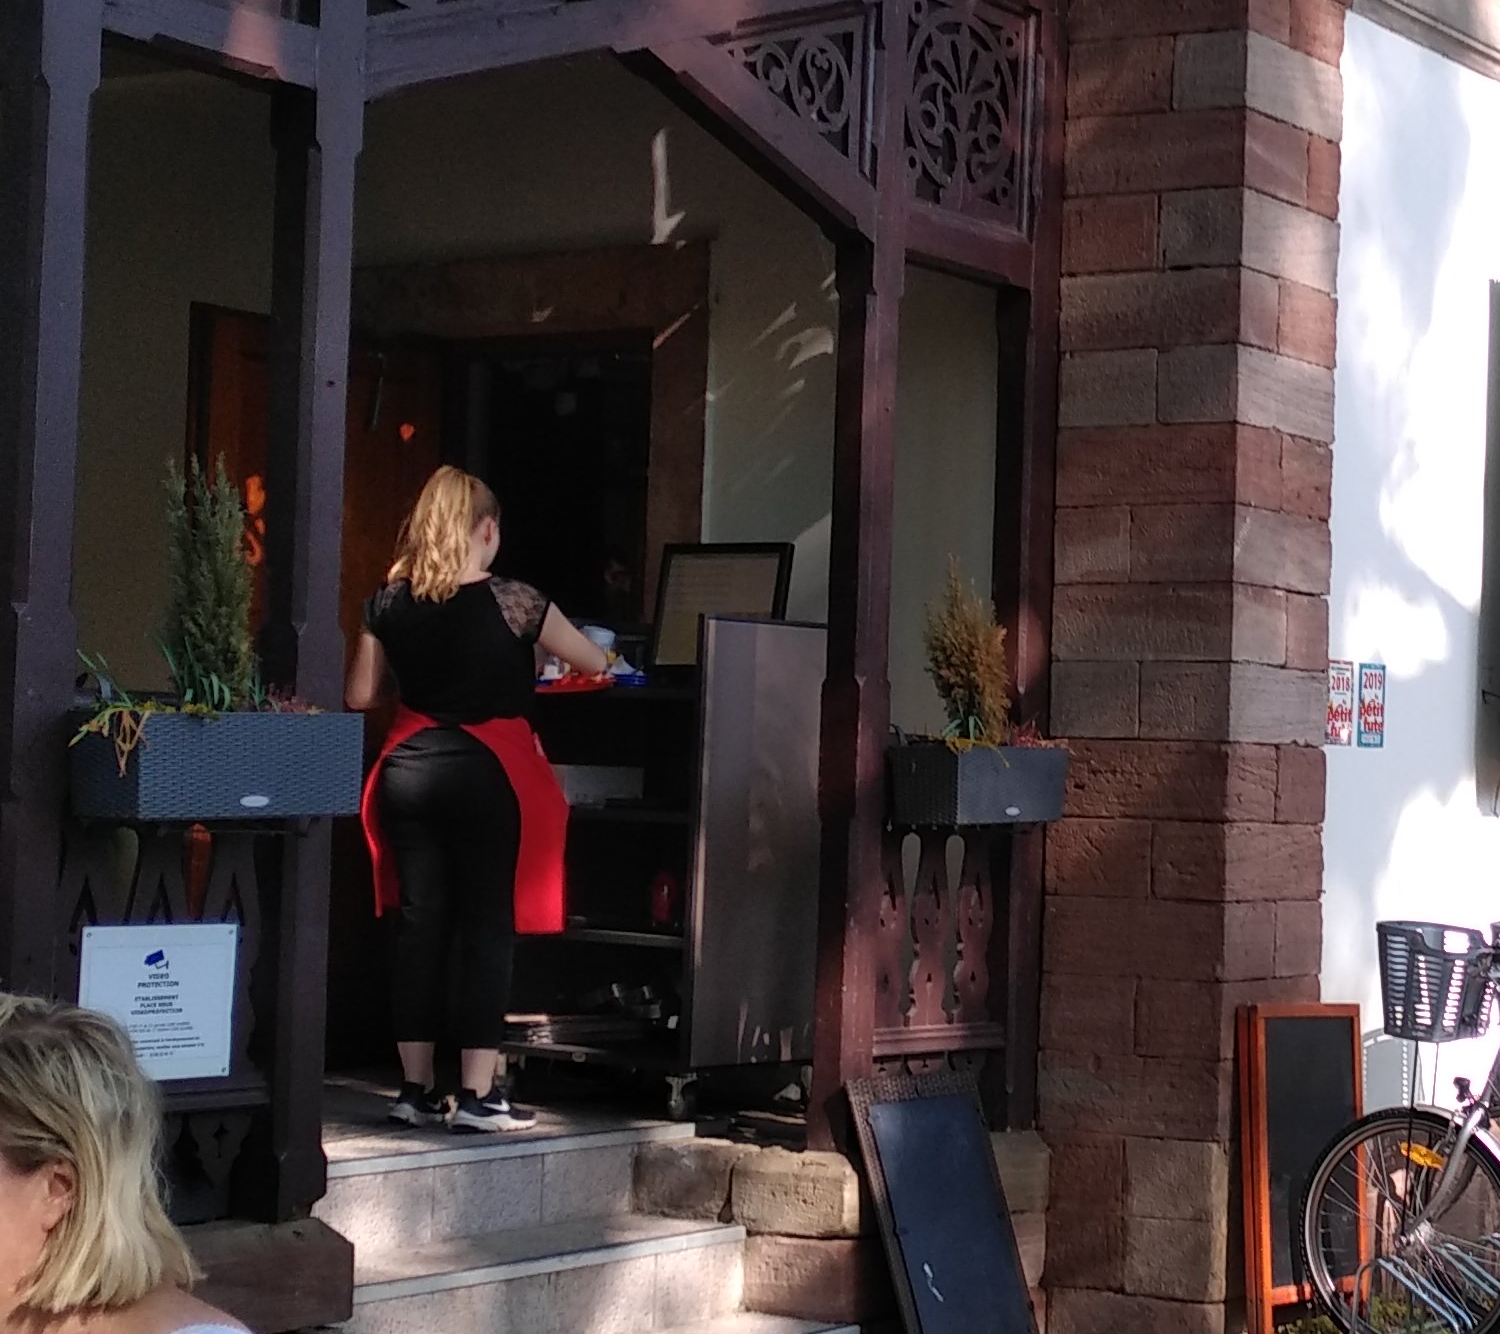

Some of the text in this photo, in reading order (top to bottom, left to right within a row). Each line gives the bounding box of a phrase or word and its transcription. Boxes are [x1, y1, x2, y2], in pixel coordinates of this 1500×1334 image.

[1331, 675, 1351, 692] 2018
[1363, 672, 1383, 691] 2019
[1360, 699, 1385, 719] petit
